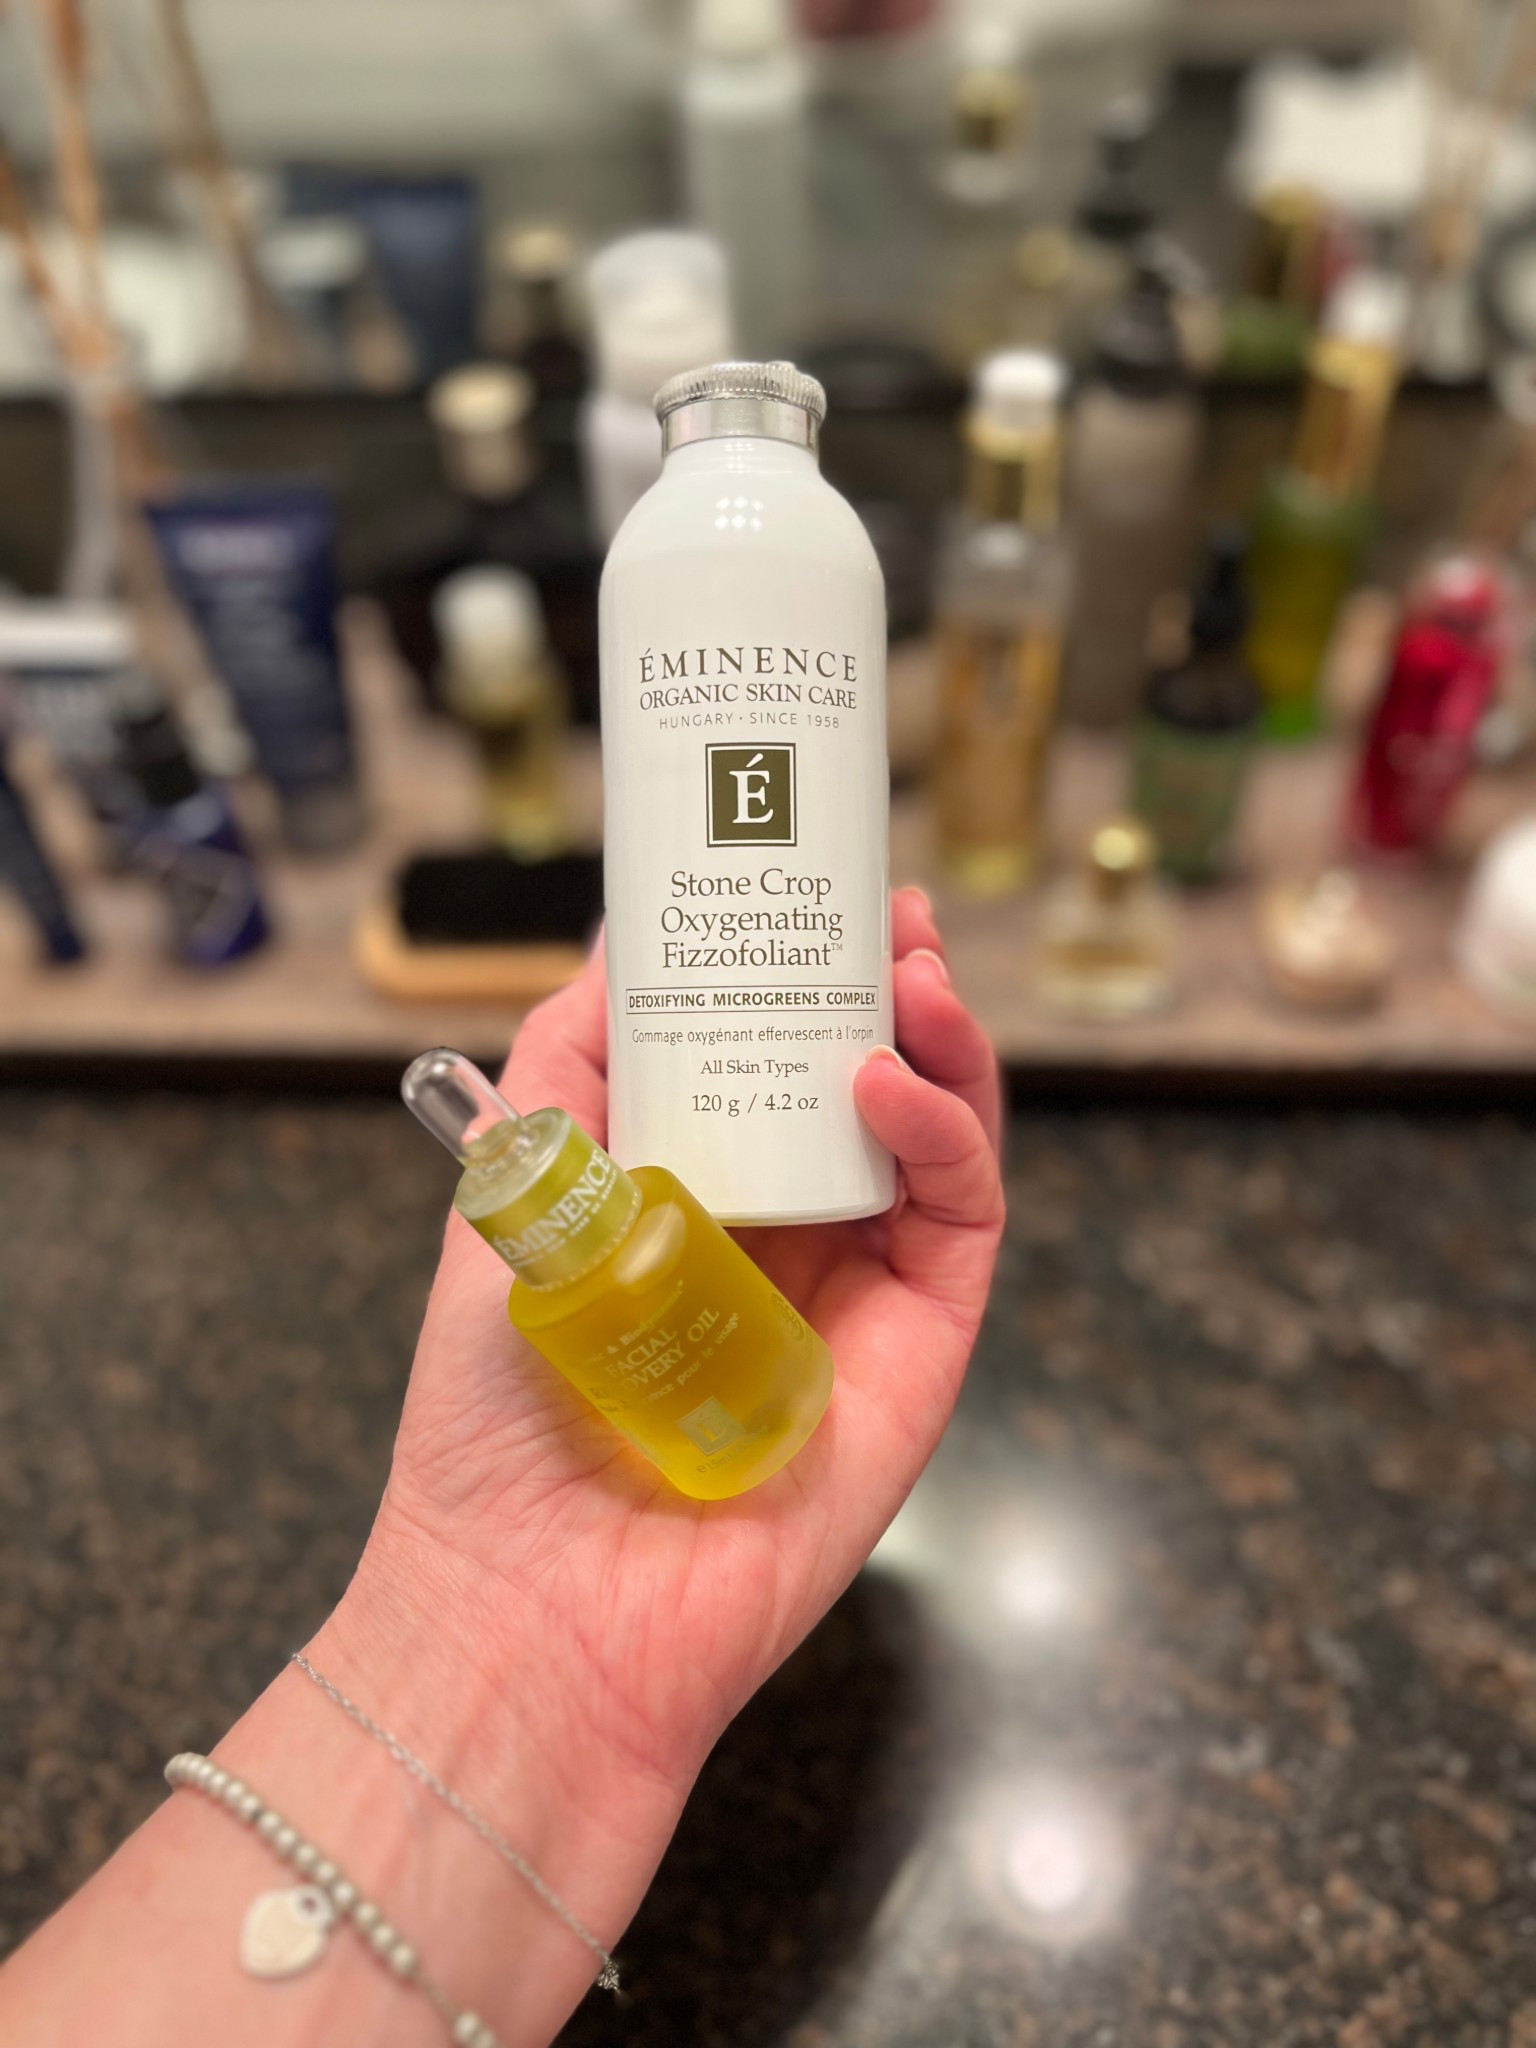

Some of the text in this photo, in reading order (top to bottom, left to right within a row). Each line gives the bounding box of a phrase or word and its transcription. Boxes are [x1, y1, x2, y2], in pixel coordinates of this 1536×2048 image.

[639, 646, 857, 684] ÉMINENCE
[640, 683, 857, 711] ORGANIC SKIN CARE
[659, 712, 840, 729] HUNGARY SINCE 1958
[728, 752, 774, 824] É
[671, 868, 832, 905] Stone Crop
[660, 905, 844, 941] Oxygenating
[629, 991, 876, 1008] DETOXIFYING MICROGREENS COMPLEX
[632, 1025, 874, 1046] Gommage oxygénant effervescent à l'orpin
[700, 1059, 809, 1077] All Skin Types
[692, 1093, 819, 1117] 120 g / 4.2 oz
[493, 1148, 611, 1260] ÉMINENCE
[688, 1308, 720, 1343] OIL
[604, 1328, 678, 1377] FACIAL
